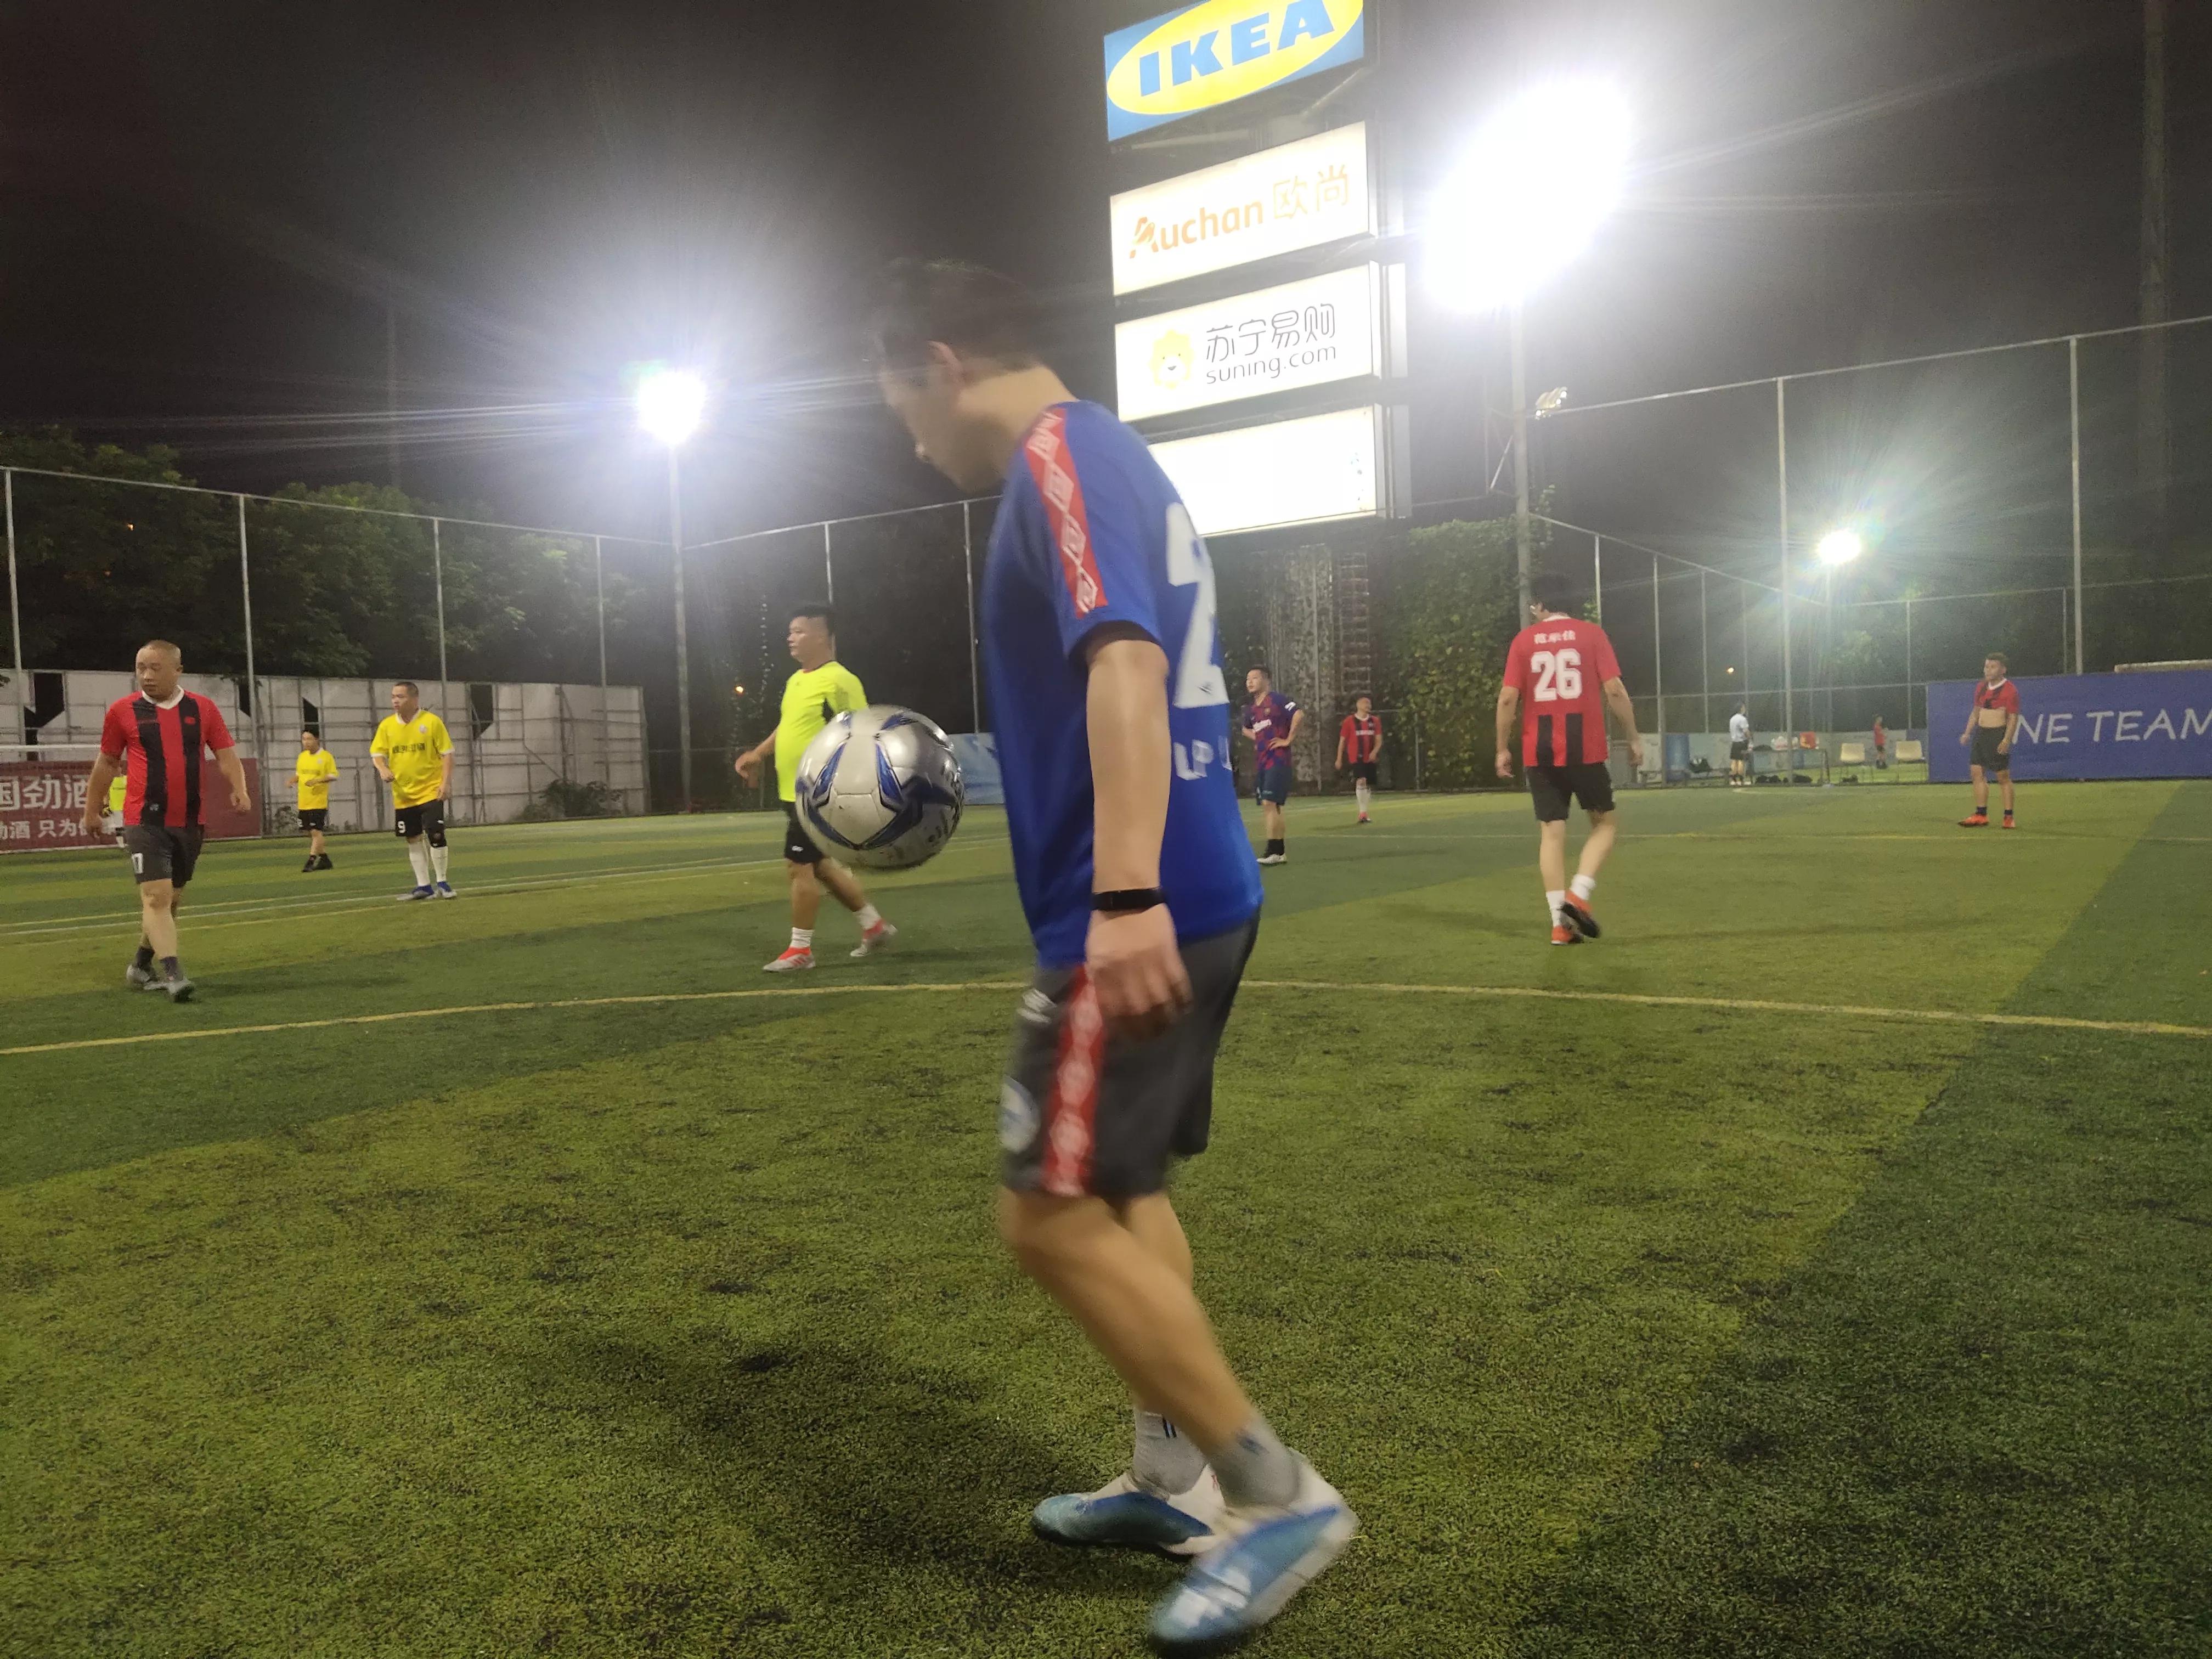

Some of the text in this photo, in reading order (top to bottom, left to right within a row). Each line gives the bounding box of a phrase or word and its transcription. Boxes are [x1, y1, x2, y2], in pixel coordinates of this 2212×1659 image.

[1139, 0, 1335, 97] IKEA
[1130, 164, 1350, 259] Auchan 欧尚
[1206, 303, 1336, 363] 苏宁易购
[1206, 346, 1336, 384] suning.com
[1530, 648, 1582, 702] 26
[2011, 708, 2212, 744] NE TEAM
